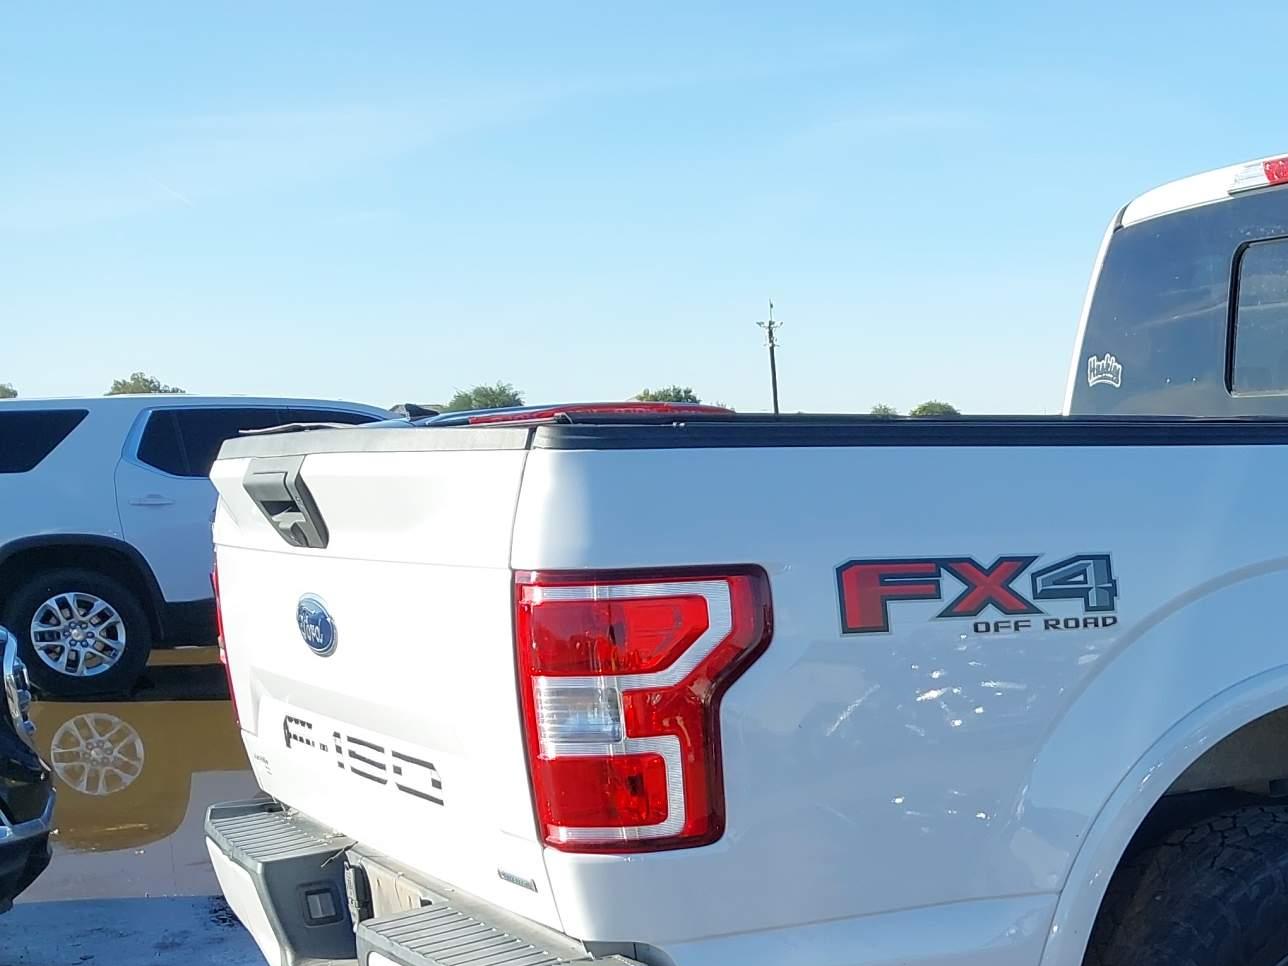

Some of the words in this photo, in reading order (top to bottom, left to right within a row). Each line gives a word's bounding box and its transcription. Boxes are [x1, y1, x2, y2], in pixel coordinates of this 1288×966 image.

[835, 553, 1118, 634] FX4
[973, 619, 1031, 633] OFF
[1043, 616, 1118, 630] ROAD
[298, 603, 328, 647] Ford
[283, 715, 445, 806] F-150
